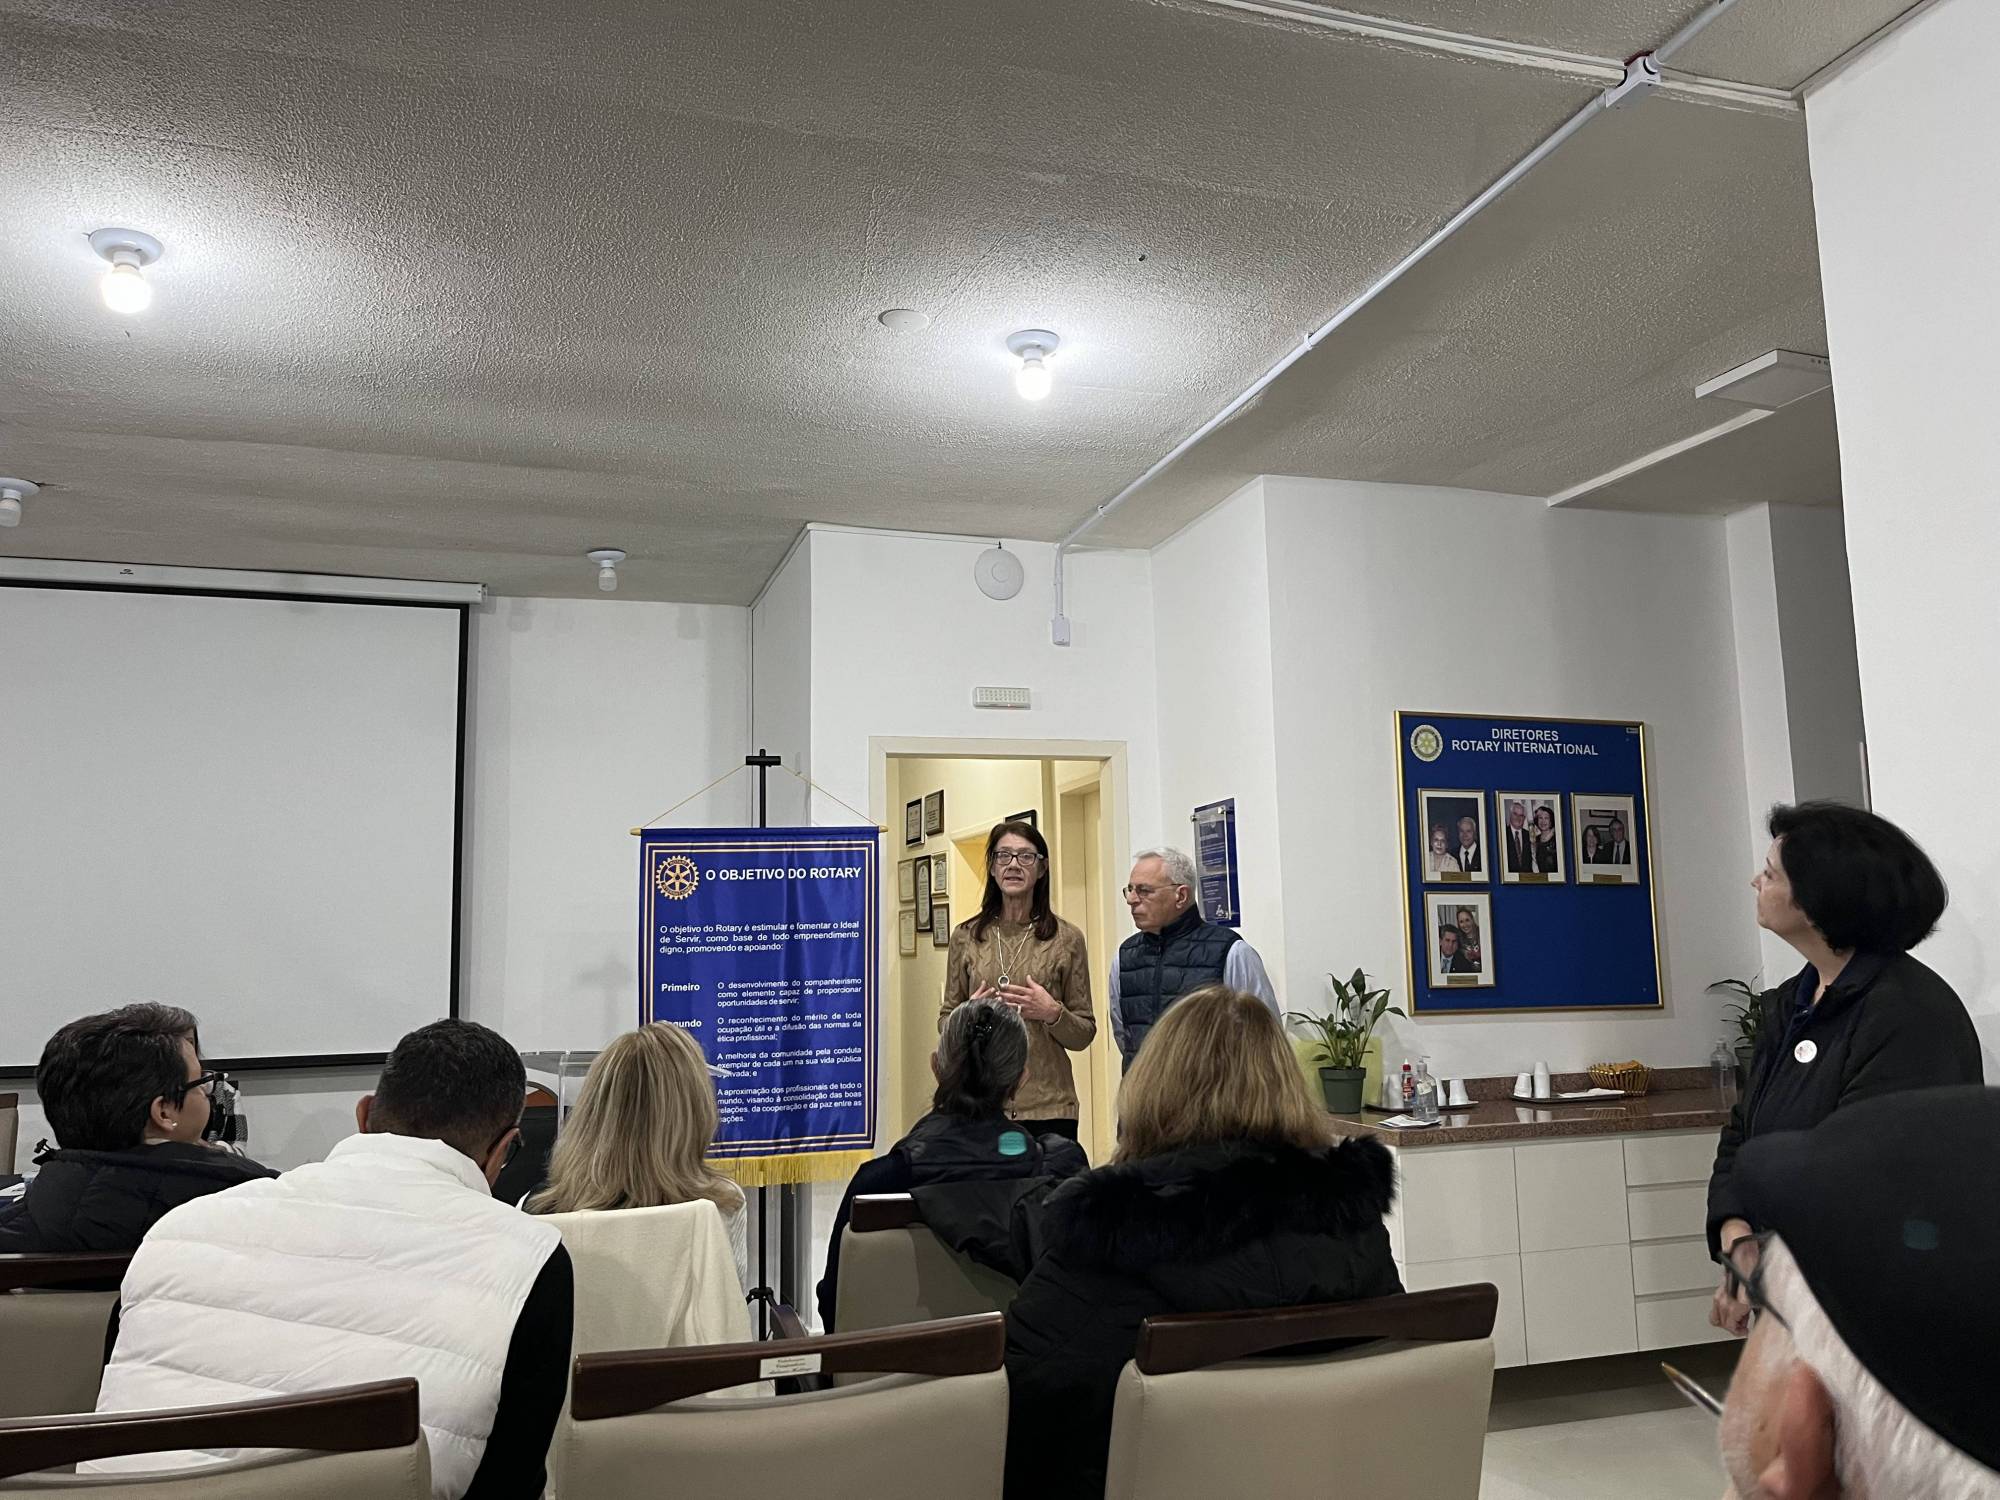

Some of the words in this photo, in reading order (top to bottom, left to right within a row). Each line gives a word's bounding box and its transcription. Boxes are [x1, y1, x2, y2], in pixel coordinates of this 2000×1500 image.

[1491, 728, 1559, 741] DIRETORES
[1451, 739, 1500, 752] ROTARY
[1503, 741, 1599, 756] INTERNATIONAL
[705, 869, 716, 881] O
[719, 869, 785, 881] OBJETIVO
[788, 868, 807, 879] DO
[810, 867, 861, 879] ROTARY
[660, 925, 668, 934] O
[669, 925, 701, 934] objetivo
[703, 925, 714, 933] do
[716, 924, 743, 933] Rotary
[745, 924, 750, 932] é
[751, 923, 788, 931] estimular
[796, 922, 831, 930] fomentar
[660, 935, 671, 944] de
[733, 934, 753, 942] base
[757, 933, 768, 941] de
[794, 931, 859, 941] empreendimento
[686, 944, 737, 954] promovendo
[661, 982, 700, 992] Primeiro
[717, 982, 725, 990] O
[728, 980, 788, 989] desenvolvimento
[804, 978, 862, 986] companheirismo
[717, 991, 738, 999] como
[741, 989, 776, 997] elemento
[779, 989, 800, 997] capaz
[803, 987, 813, 995] de
[817, 986, 862, 995] proporcionar
[717, 999, 768, 1008] oportunidades
[717, 1017, 725, 1025] O
[728, 1015, 788, 1024] reconhecimento
[791, 1014, 801, 1022] do
[804, 1013, 828, 1021] mérito
[831, 1012, 842, 1020] de
[717, 1025, 752, 1034] ocupação
[808, 1022, 822, 1030] das
[823, 1021, 851, 1029] normas
[717, 1035, 735, 1043] ética
[717, 1052, 724, 1060] A
[725, 1051, 757, 1060] melhoria
[759, 1051, 769, 1059] da
[771, 1049, 813, 1058] comunidade
[815, 1048, 831, 1056] pela
[833, 1046, 862, 1054] conduta
[717, 1061, 751, 1070] exemplar
[752, 1060, 762, 1068] de
[782, 1058, 794, 1066] um
[805, 1057, 819, 1065] sua
[820, 1055, 835, 1064] vida
[836, 1055, 862, 1065] pública
[717, 1088, 724, 1096] A
[724, 1086, 770, 1097] aproximação
[785, 1083, 829, 1093] profissionais
[829, 1082, 839, 1090] de
[746, 1096, 775, 1104] visando
[783, 1092, 828, 1102] consolidação
[829, 1091, 843, 1099] das
[844, 1090, 862, 1098] boas
[751, 1104, 761, 1113] da
[762, 1102, 802, 1112] cooperação
[809, 1101, 819, 1109] da
[819, 1101, 833, 1110] paz
[833, 1100, 852, 1108] entre
